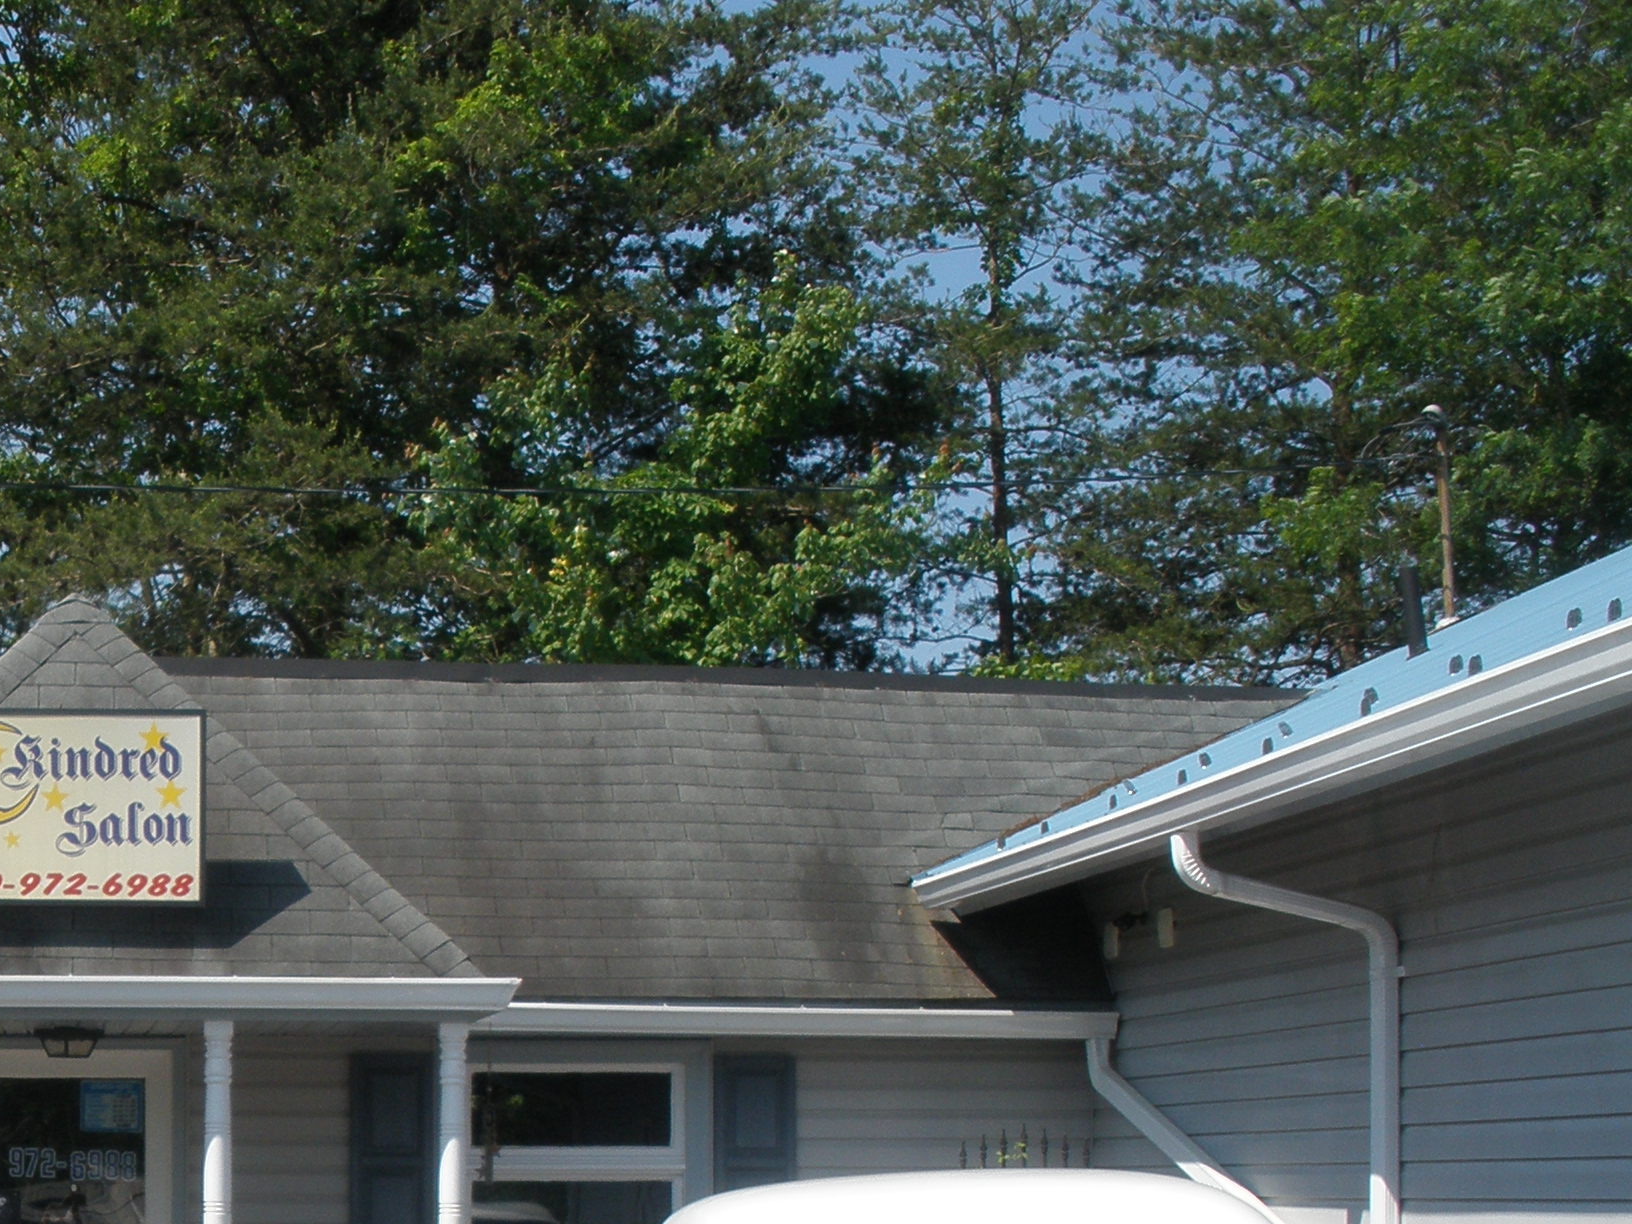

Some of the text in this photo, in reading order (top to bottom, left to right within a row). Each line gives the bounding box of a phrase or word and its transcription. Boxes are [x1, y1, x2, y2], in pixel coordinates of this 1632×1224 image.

[0, 734, 183, 790] Kindred
[55, 801, 194, 857] Salon
[8, 1147, 137, 1182] 972-6988
